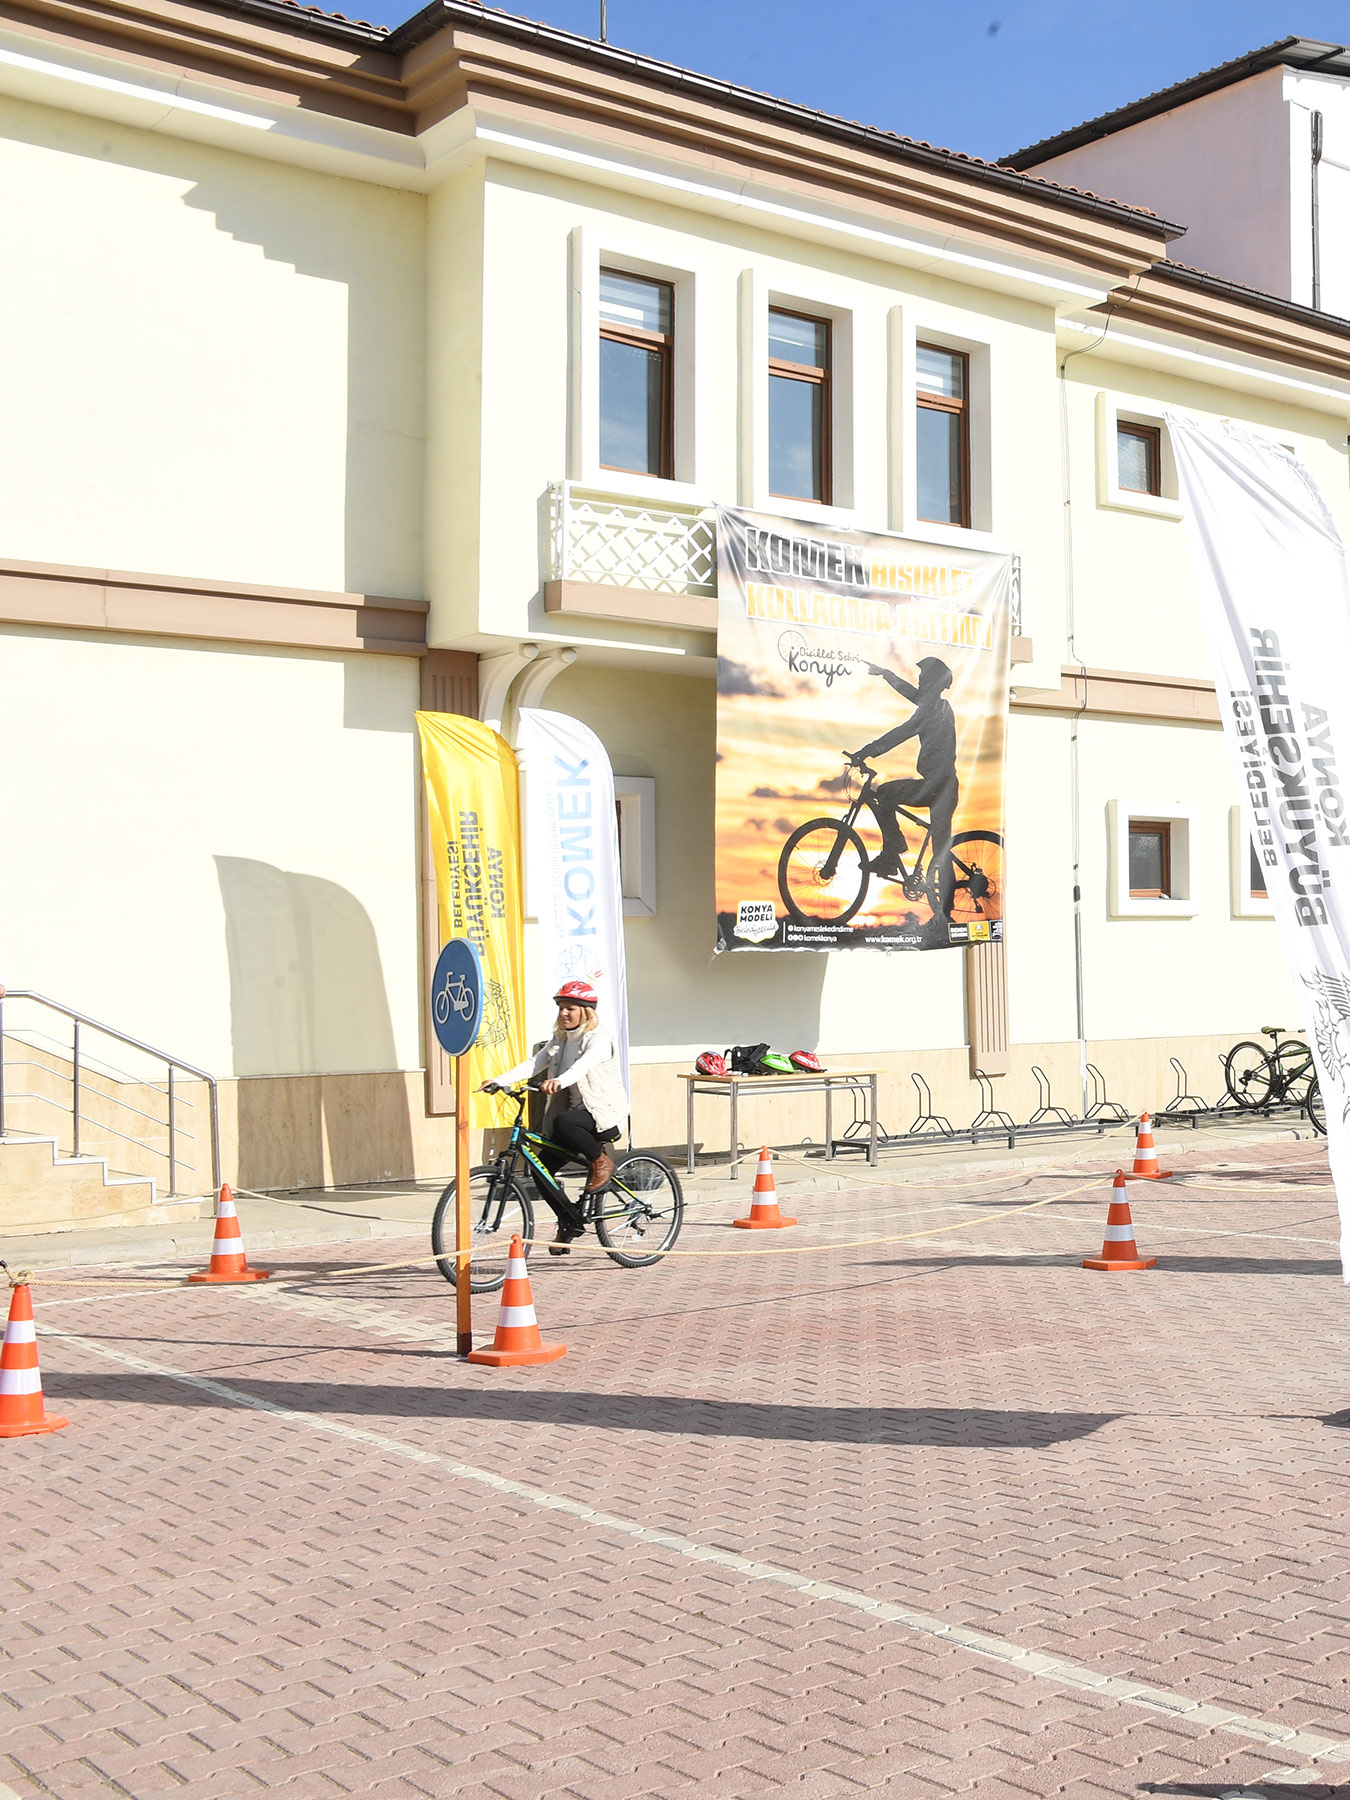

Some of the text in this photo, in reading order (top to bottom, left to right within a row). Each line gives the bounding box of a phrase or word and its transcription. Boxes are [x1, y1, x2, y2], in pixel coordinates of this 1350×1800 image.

[746, 527, 868, 586] KOMEK
[745, 582, 892, 636] KULLANMA
[788, 648, 852, 687] Konya
[739, 913, 773, 923] MODELİ
[740, 904, 773, 914] KONYA
[865, 935, 923, 945] www.komek.org.tr
